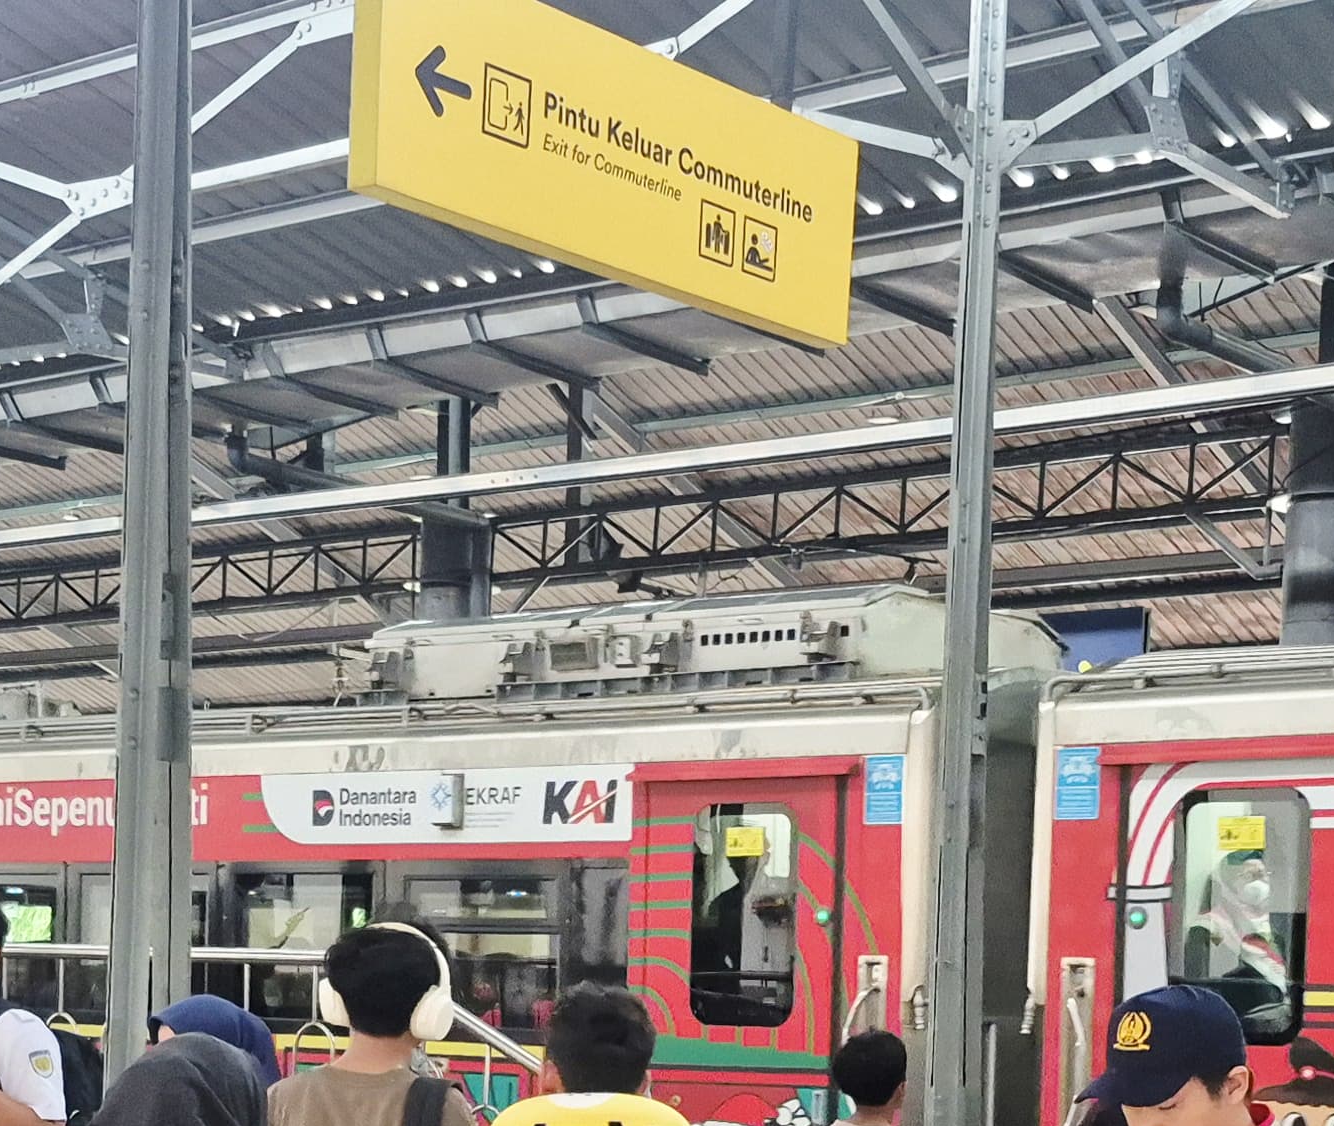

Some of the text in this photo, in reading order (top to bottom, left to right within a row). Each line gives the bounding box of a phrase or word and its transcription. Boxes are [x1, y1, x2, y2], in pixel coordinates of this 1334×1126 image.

[542, 132, 683, 202] Exit for Commuterline
[543, 91, 813, 223] Pintu Keluar Commuterline
[339, 787, 417, 806] Danantara
[465, 786, 522, 806] EKRAF
[542, 779, 618, 825] KAI
[339, 808, 411, 827] Indonesia
